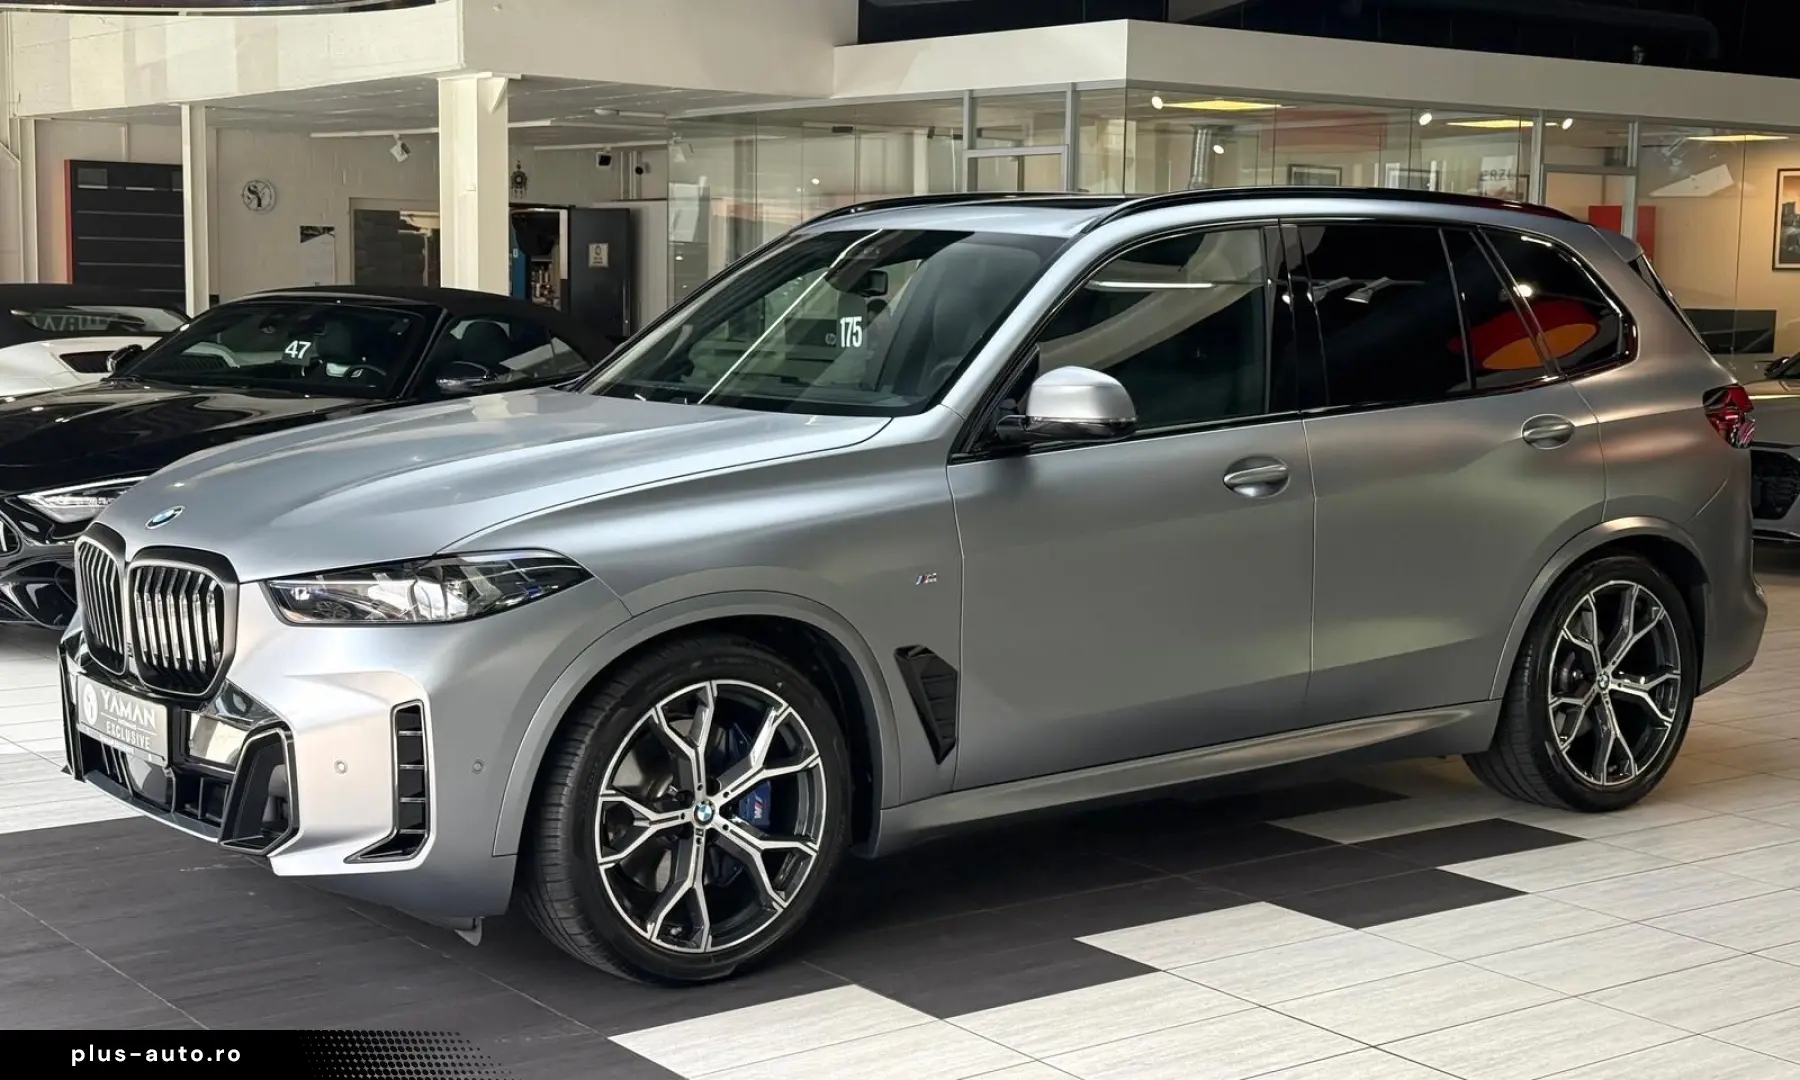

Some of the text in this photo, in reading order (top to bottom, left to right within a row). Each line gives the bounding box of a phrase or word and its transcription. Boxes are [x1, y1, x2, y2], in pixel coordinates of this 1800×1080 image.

[840, 315, 862, 348] 175
[284, 340, 312, 359] 47
[100, 689, 156, 729] YAMAN
[106, 721, 150, 750] EXCLUSIVE
